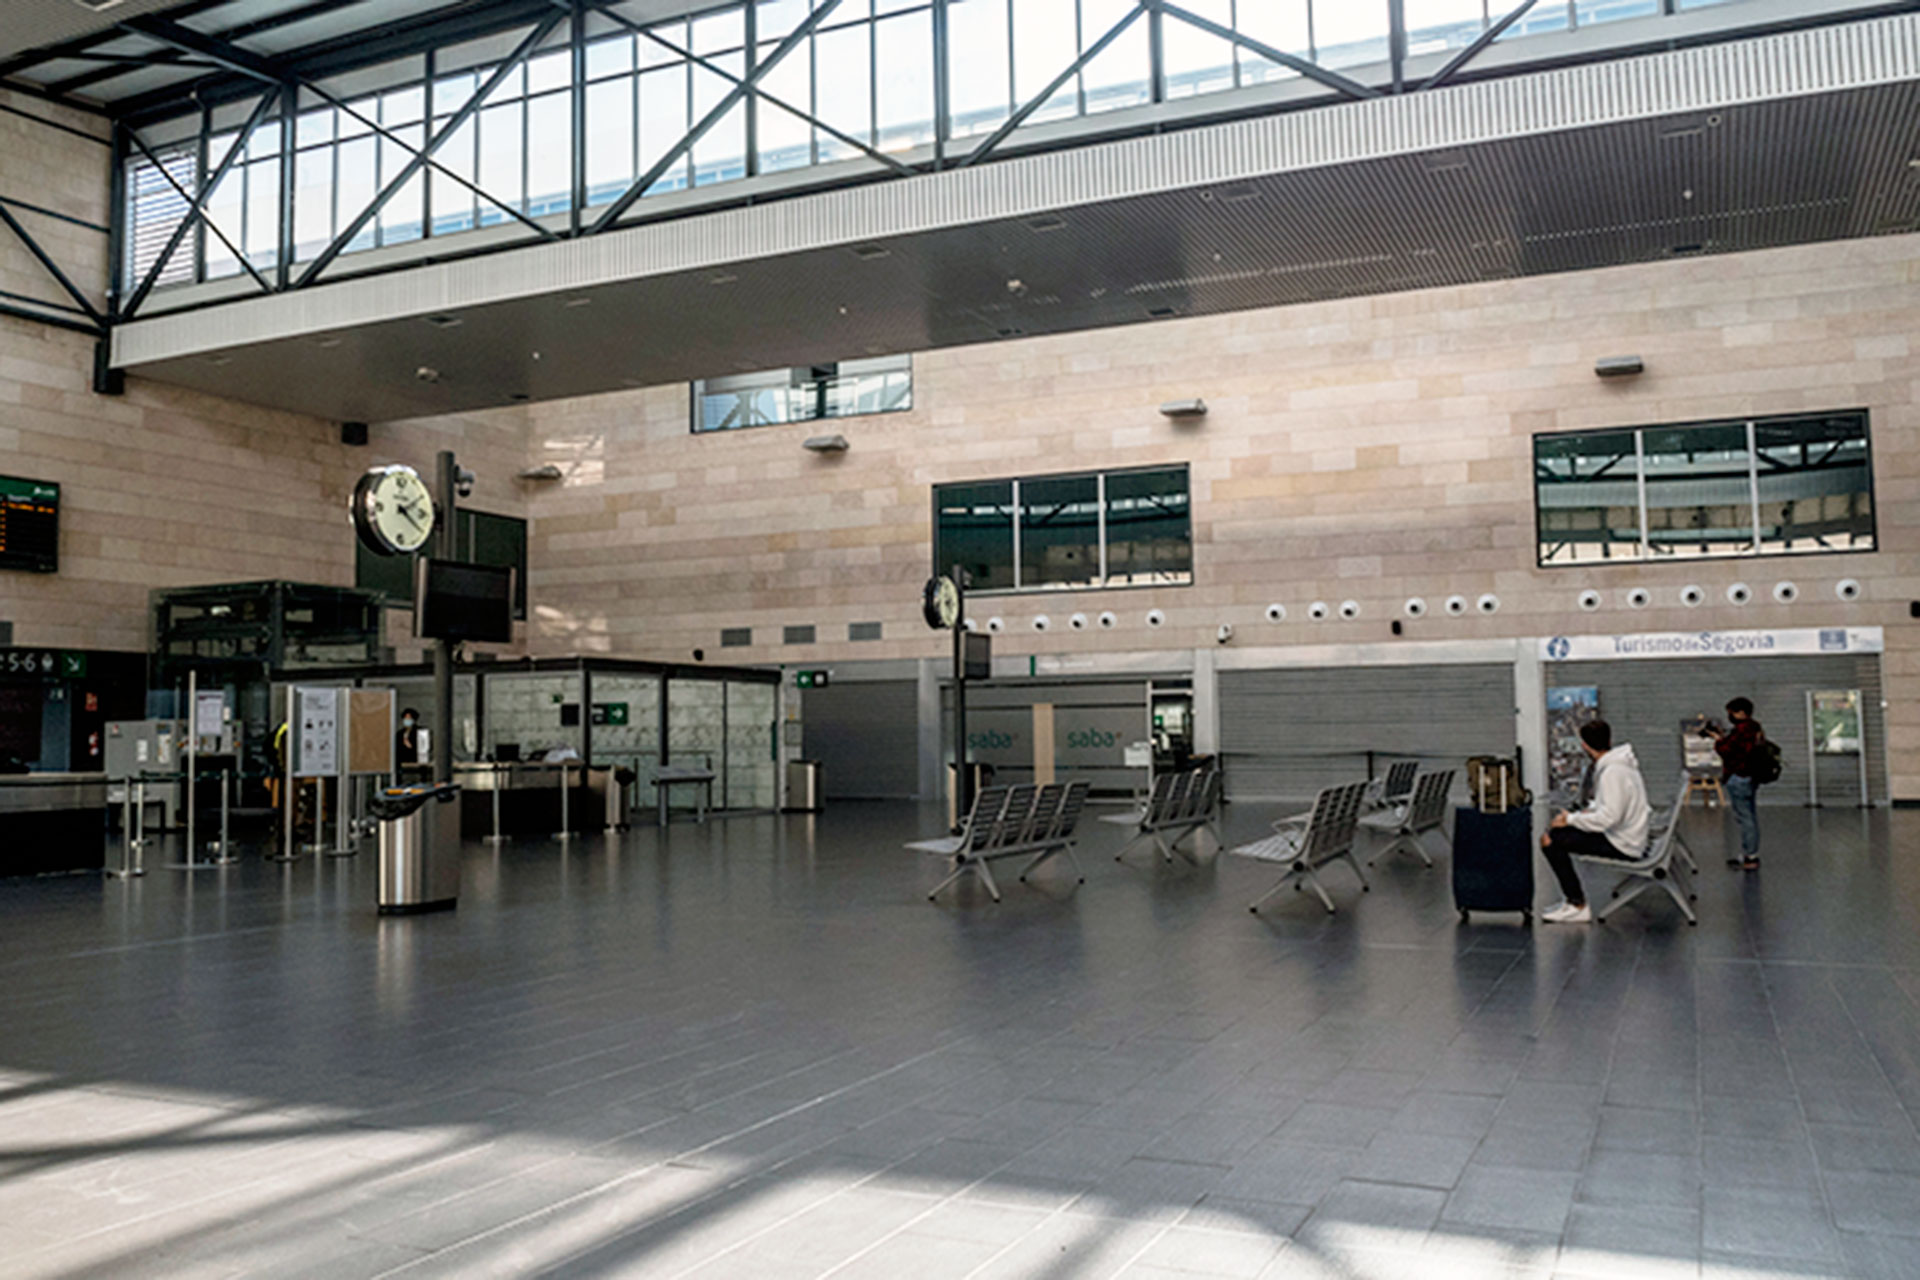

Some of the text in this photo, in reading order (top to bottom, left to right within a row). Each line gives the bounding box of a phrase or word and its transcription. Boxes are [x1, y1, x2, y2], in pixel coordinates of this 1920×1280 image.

[1612, 635, 1682, 653] Turismo
[1699, 631, 1775, 653] Segovia
[967, 728, 1013, 749] saba
[1067, 728, 1115, 748] saba
